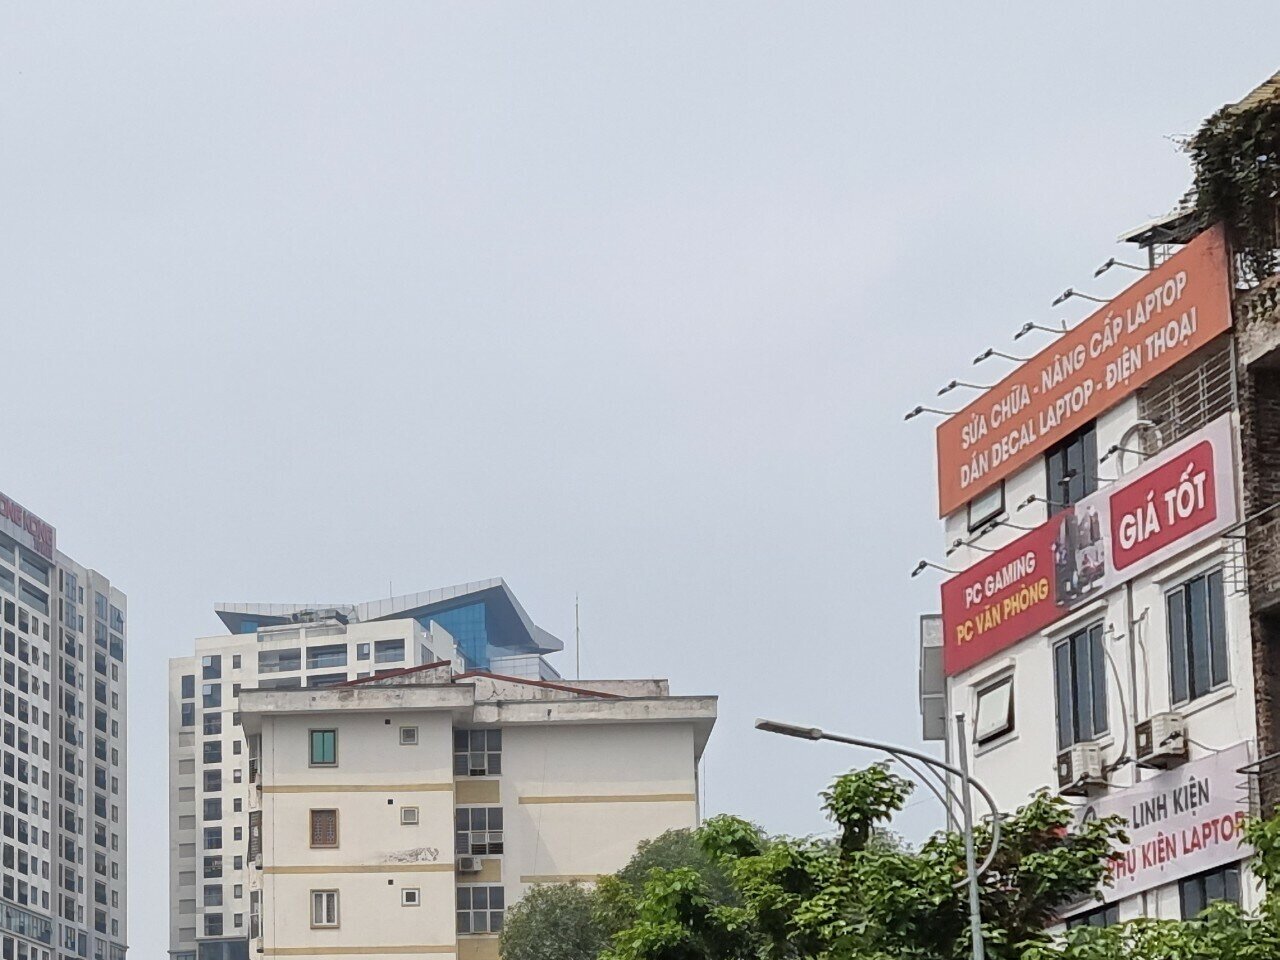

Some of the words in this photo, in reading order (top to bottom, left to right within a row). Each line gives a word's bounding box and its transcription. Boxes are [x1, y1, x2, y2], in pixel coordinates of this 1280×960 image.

[961, 413, 988, 450] SỬA
[990, 384, 1031, 429] CHỮA
[1041, 344, 1086, 394] NÂNG
[1089, 310, 1123, 358] CẤP
[1126, 271, 1187, 334] LAPTOP
[960, 451, 989, 489] DÁN
[991, 418, 1037, 468] DECAL
[1039, 378, 1094, 436] LAPTOP
[1105, 344, 1142, 391] ĐIỆN
[1145, 306, 1197, 362] THOẠI
[1119, 489, 1161, 550] GIÁ
[1164, 461, 1206, 526] TỐT
[956, 620, 974, 646] PC
[975, 603, 1002, 635] VĂN
[1002, 578, 1049, 620] PHÒNG
[965, 582, 983, 609] PC
[985, 551, 1036, 598] GAMING
[1132, 793, 1168, 829] LINH
[1172, 775, 1210, 816] KIỆN
[1107, 848, 1137, 882] PHỤ
[1141, 831, 1177, 872] KIỆN
[1182, 810, 1245, 856] LAPTOP
